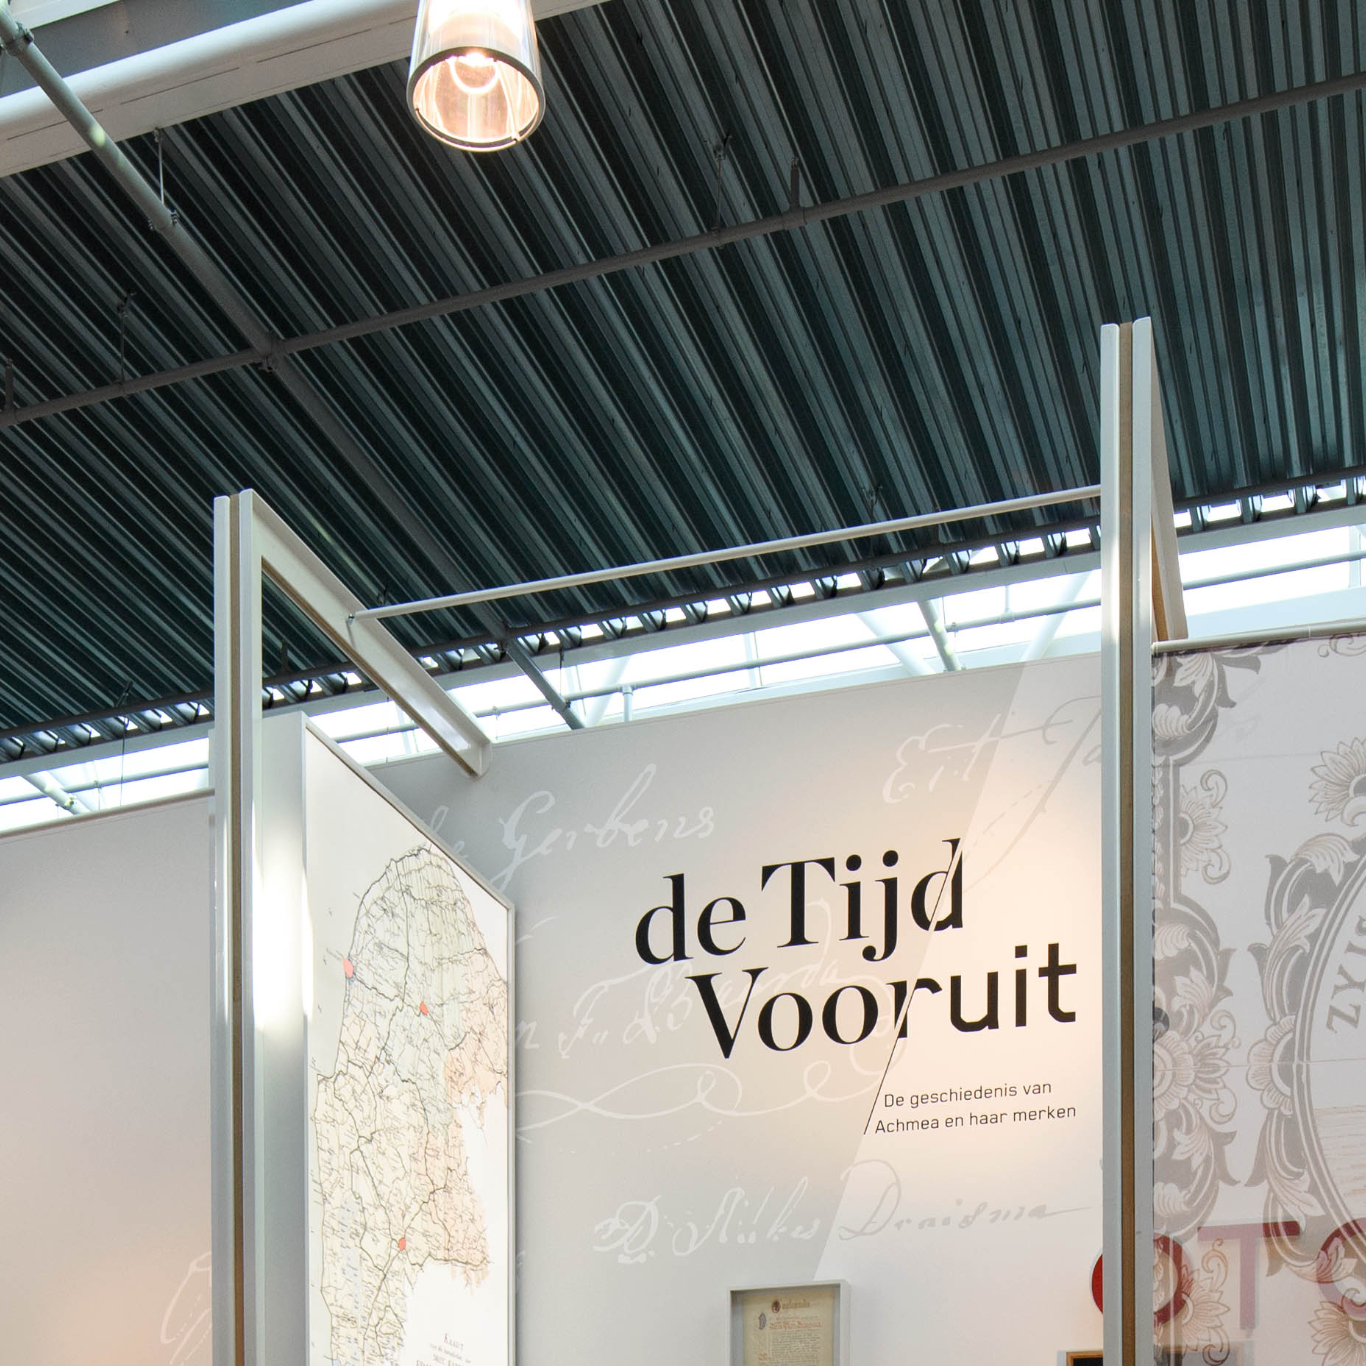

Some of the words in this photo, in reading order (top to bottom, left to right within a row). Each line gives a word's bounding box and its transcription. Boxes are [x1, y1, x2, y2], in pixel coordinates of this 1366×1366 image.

[635, 874, 746, 965] de
[761, 838, 964, 962] Tijd
[686, 942, 1077, 1060] Vooruit
[875, 1115, 940, 1134] Achmea
[945, 1117, 965, 1130] en
[969, 1110, 1009, 1128] haar
[1013, 1104, 1077, 1123] merken
[884, 1089, 905, 1108] De
[910, 1082, 1018, 1110] geschiedenis
[1023, 1083, 1052, 1097] van
